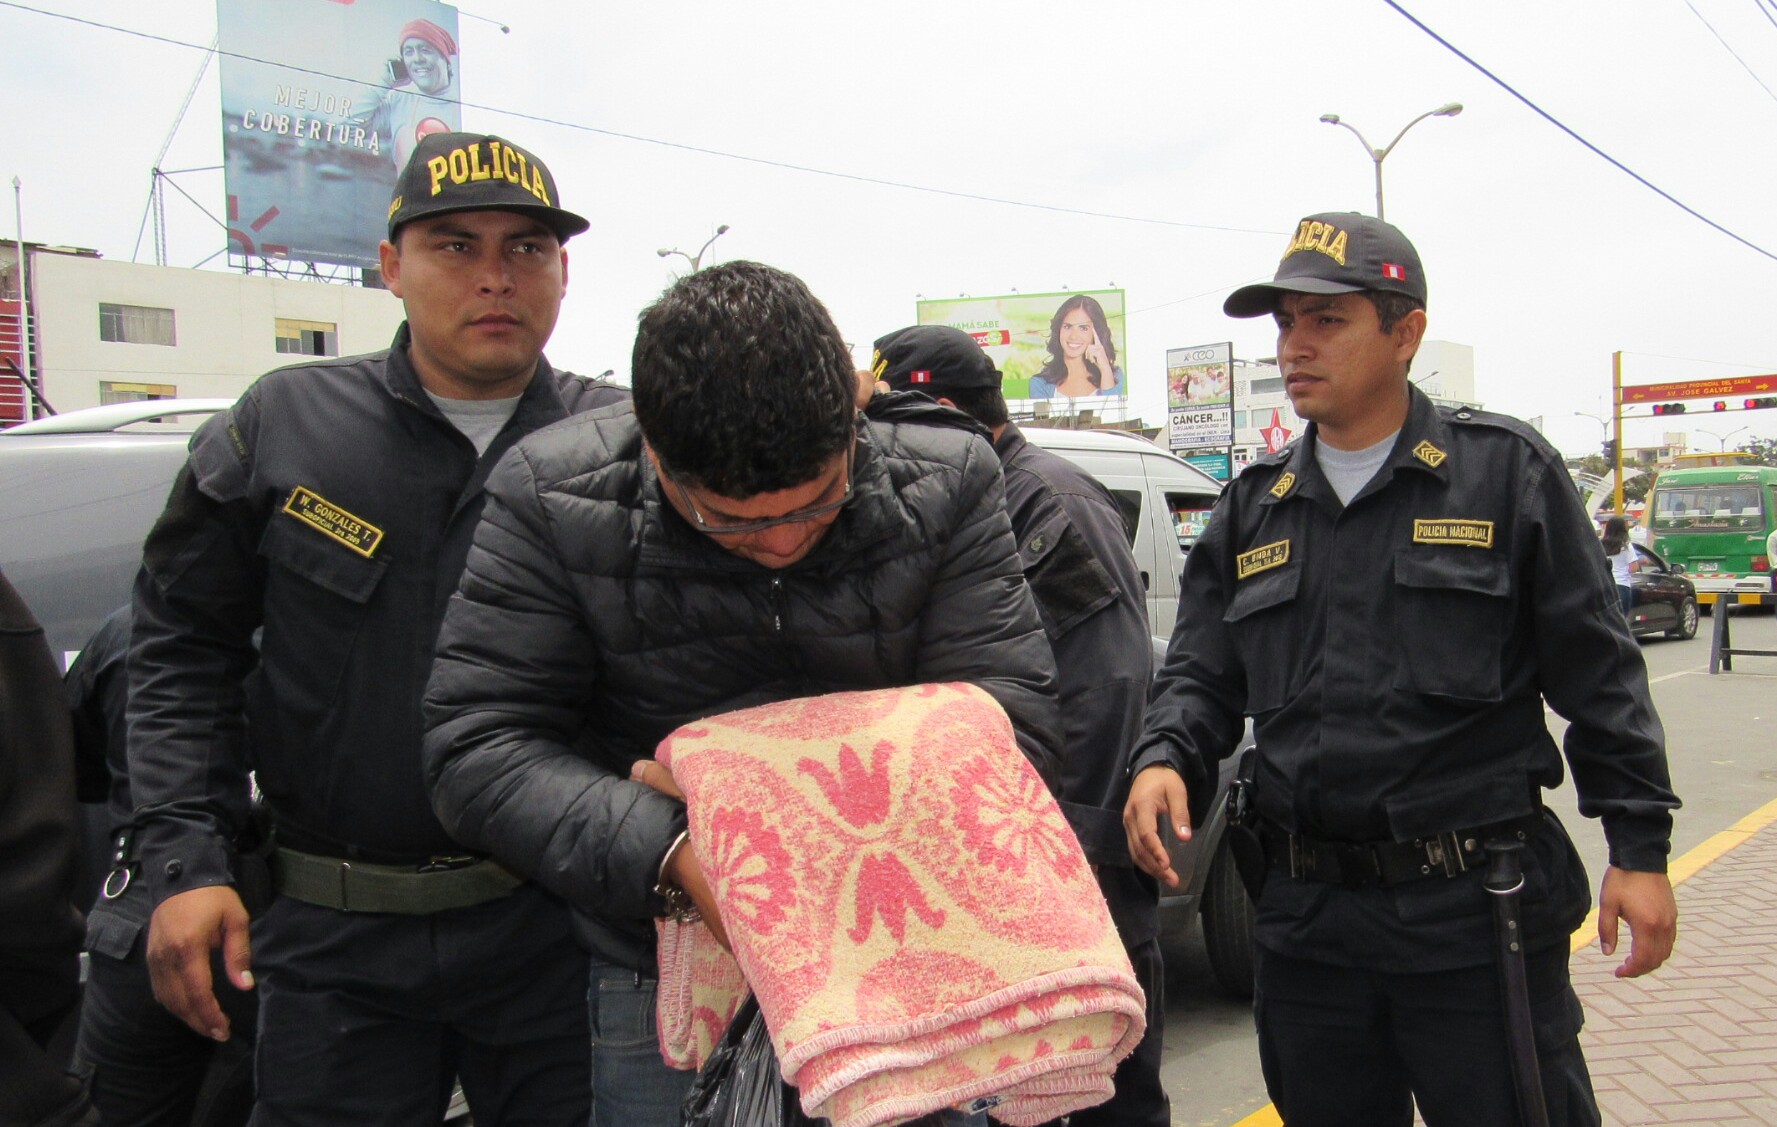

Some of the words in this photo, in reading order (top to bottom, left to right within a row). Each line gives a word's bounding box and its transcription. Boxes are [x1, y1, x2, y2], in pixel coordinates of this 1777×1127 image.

[243, 108, 380, 151] COBERTURA
[427, 141, 551, 207] POLICIA
[977, 320, 1000, 329] SABE
[1704, 386, 1733, 394] GALVEZ
[315, 503, 361, 535] GONZALES
[1418, 525, 1447, 537] POLICIA
[1449, 525, 1487, 540] NACIONAL
